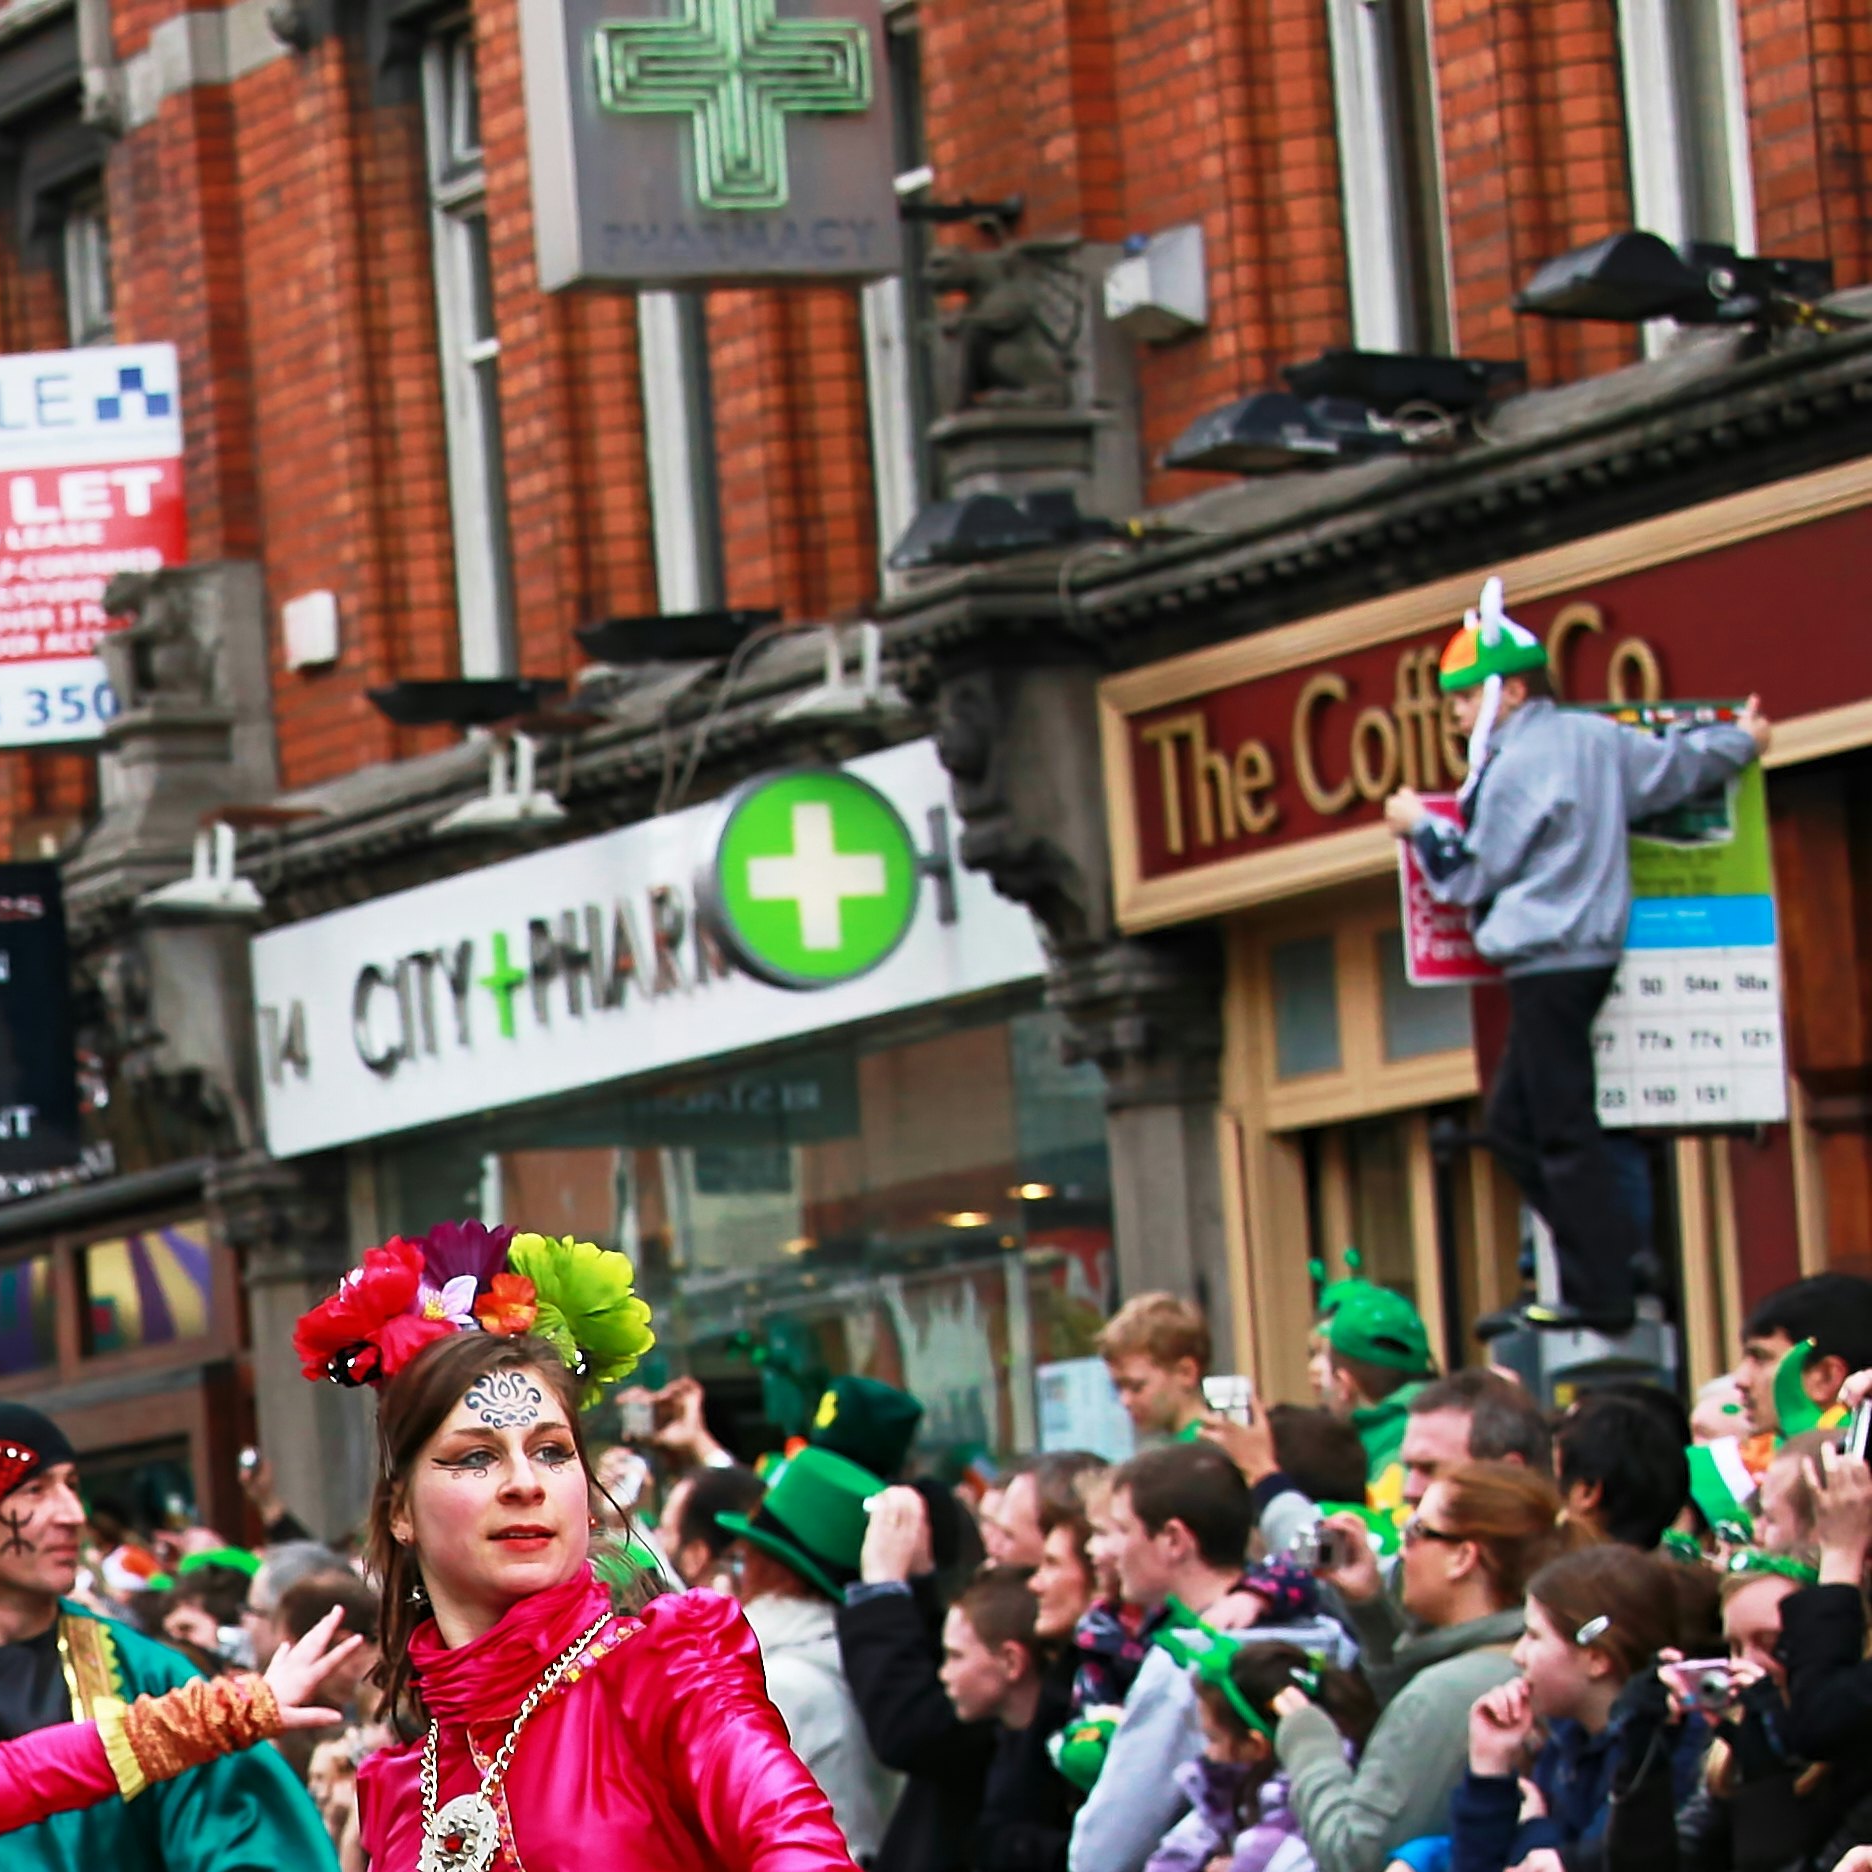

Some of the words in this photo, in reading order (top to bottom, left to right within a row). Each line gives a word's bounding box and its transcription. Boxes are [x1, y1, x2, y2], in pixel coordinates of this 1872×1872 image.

[602, 216, 875, 265] PHARMACY
[8, 467, 164, 526] LET
[4, 520, 105, 551] LEASE
[1140, 710, 1279, 857] The
[1291, 645, 1469, 818] Coffe
[351, 938, 475, 1079] CITY
